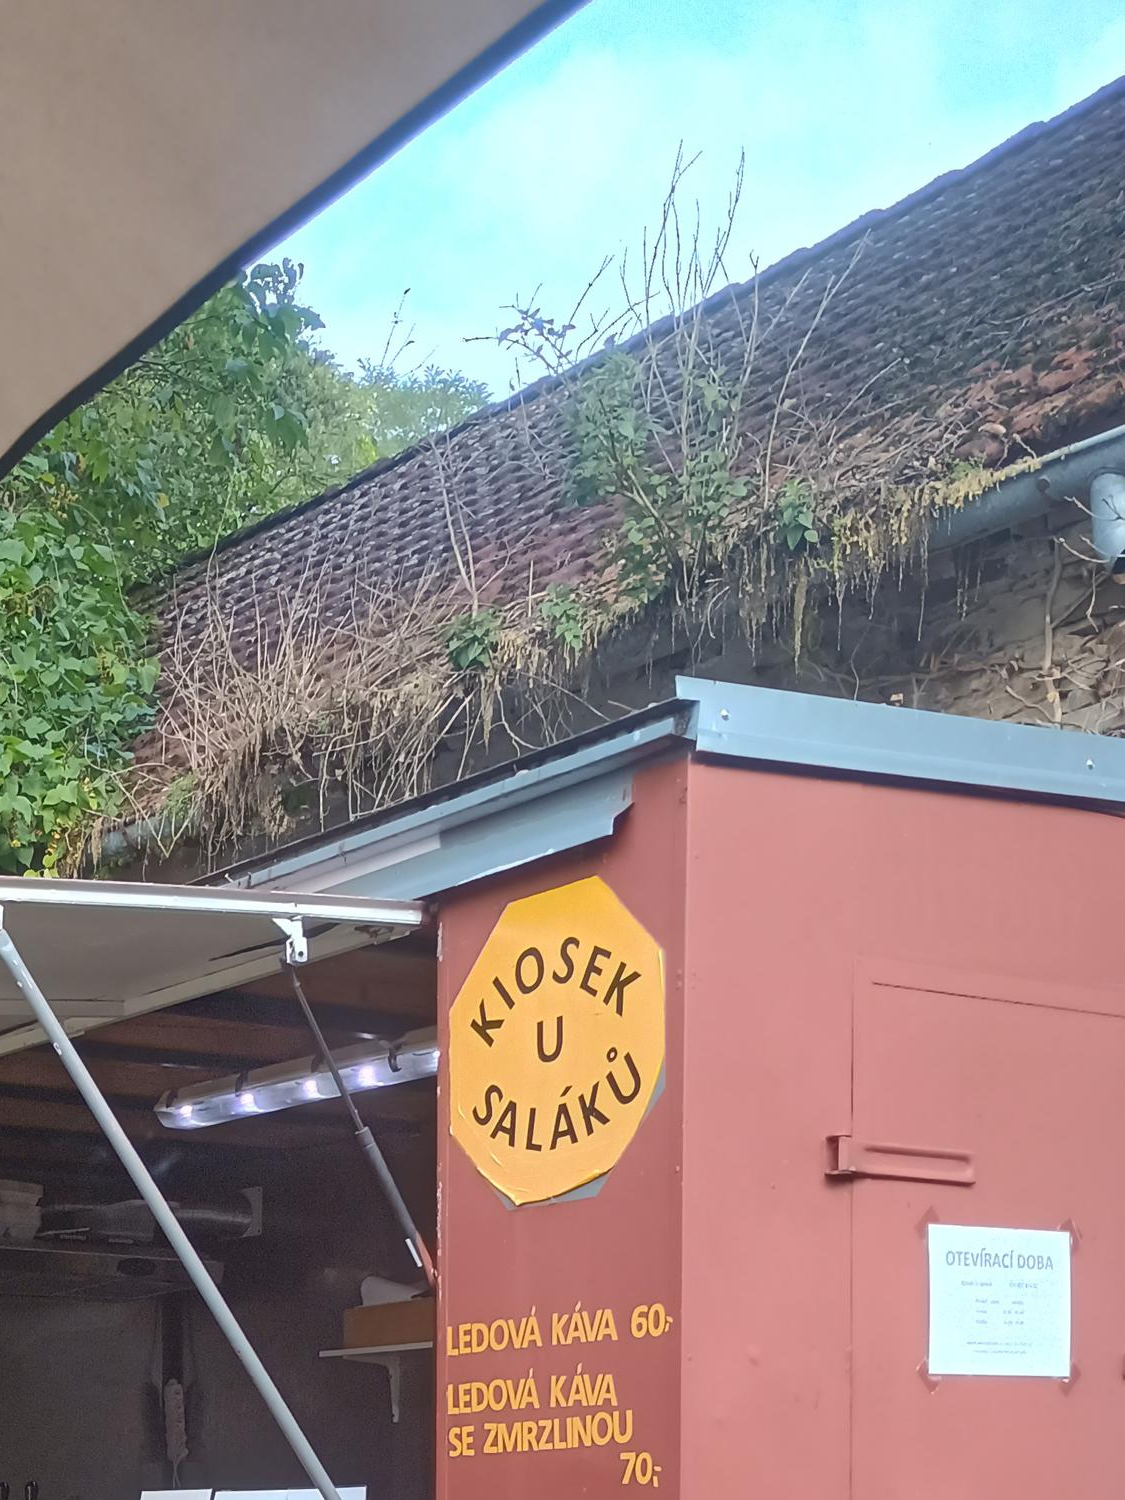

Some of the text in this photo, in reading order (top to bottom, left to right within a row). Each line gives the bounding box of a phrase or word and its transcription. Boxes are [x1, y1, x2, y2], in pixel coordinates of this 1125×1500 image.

[470, 937, 641, 1047] KIOSEK
[536, 1016, 564, 1062] U
[472, 1047, 641, 1152] SALÁKŮ
[945, 1247, 1054, 1271] OTEVÍRACÍ DOBA
[446, 1305, 542, 1356] LEDOVÁ
[551, 1301, 618, 1346] KÁVA
[446, 1363, 618, 1415] LEDOVÁ KÁVA
[448, 1410, 633, 1457] SE ZMRZLINOU
